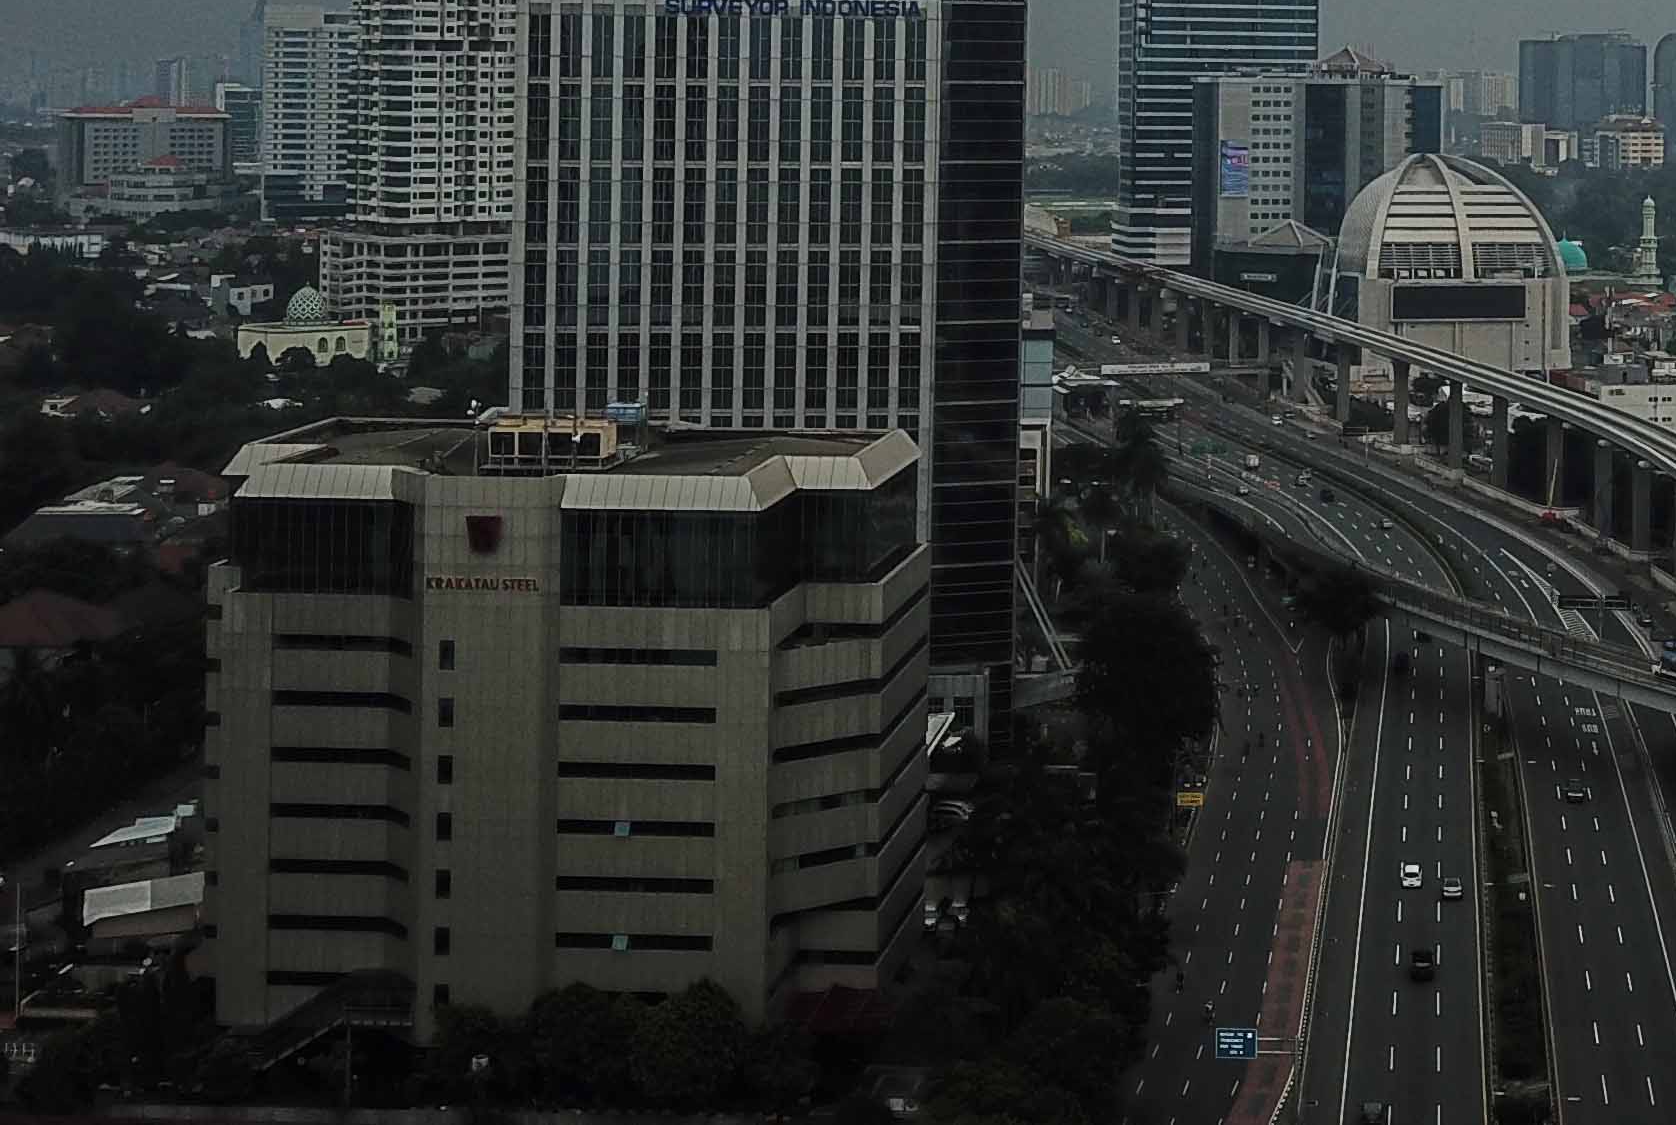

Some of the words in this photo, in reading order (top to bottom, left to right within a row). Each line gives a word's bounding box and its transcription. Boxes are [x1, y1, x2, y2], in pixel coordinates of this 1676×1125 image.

[801, 0, 921, 16] INDONESIA
[426, 577, 499, 589] KRAKATAU
[502, 578, 539, 592] STEEL
